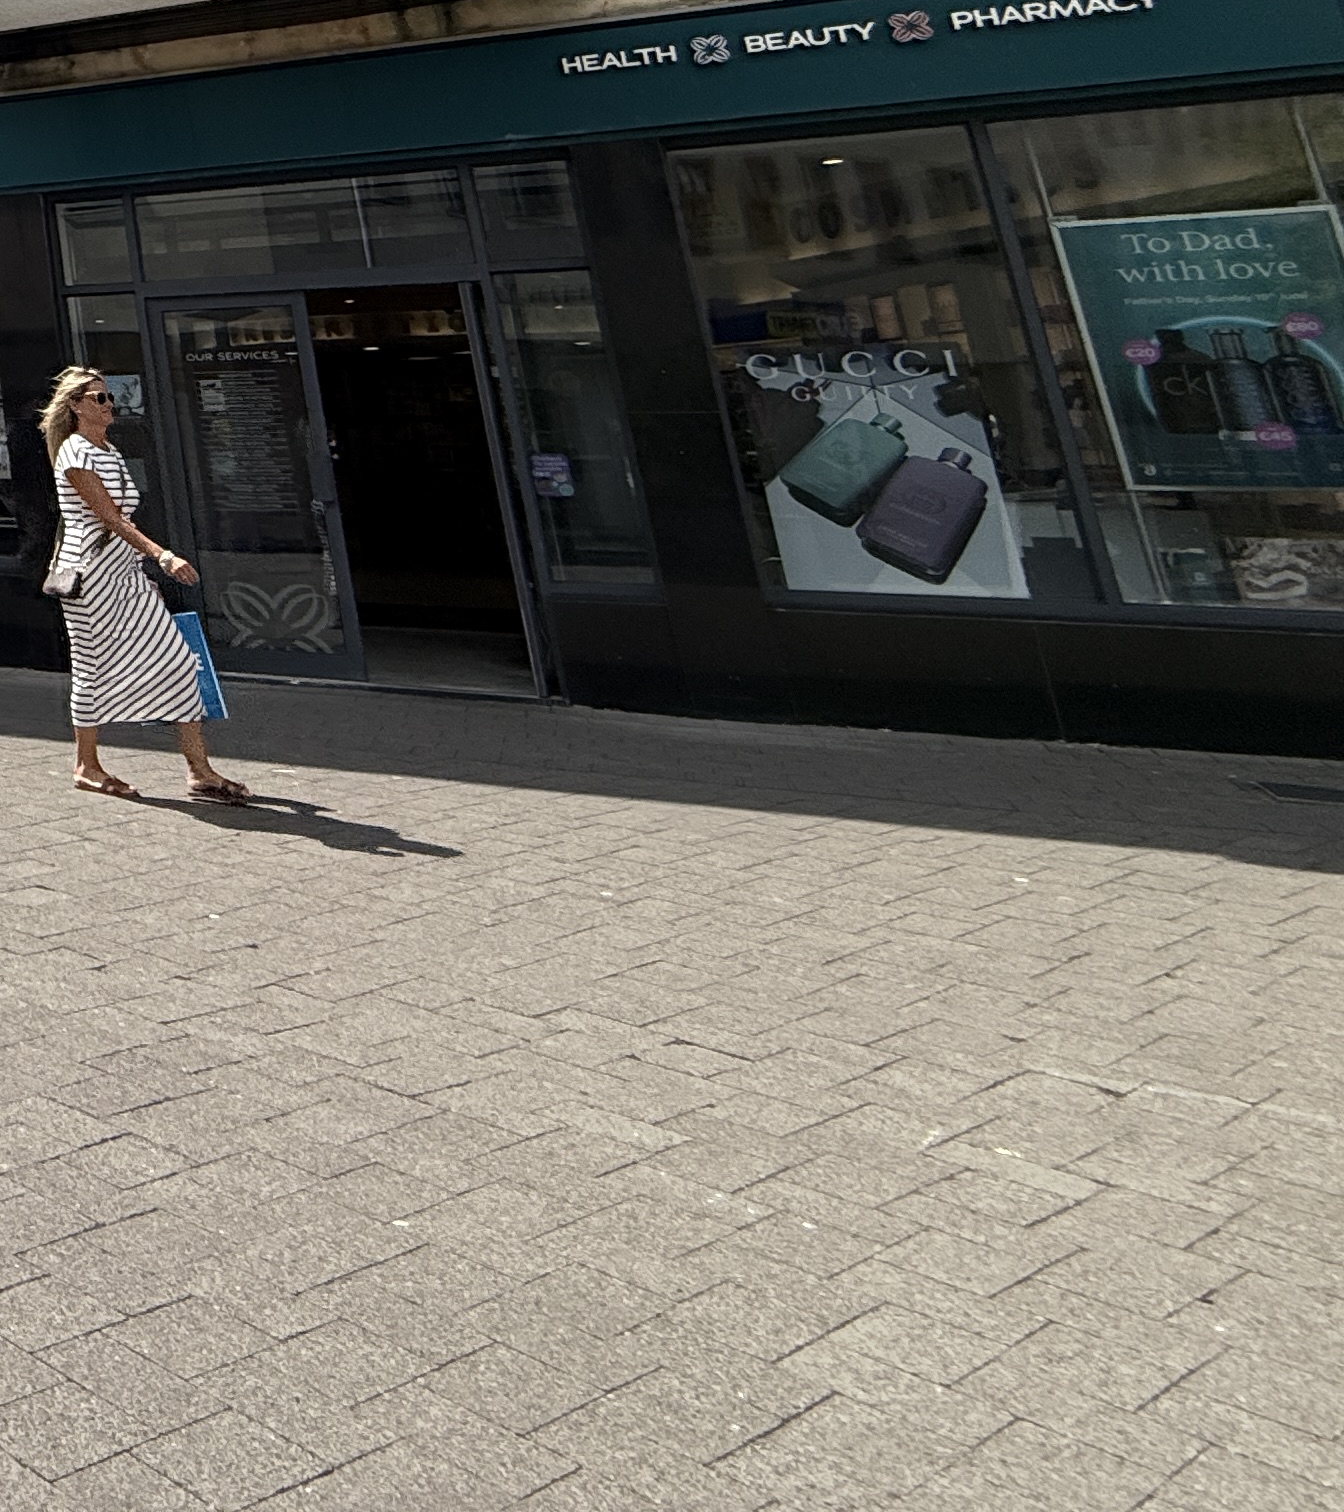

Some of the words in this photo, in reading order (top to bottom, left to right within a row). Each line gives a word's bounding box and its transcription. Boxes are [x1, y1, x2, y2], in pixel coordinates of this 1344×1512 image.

[561, 44, 677, 75] HEALTH
[743, 21, 876, 54] BEAUTY
[1120, 233, 1171, 254] To
[1116, 260, 1205, 284] with
[1212, 259, 1301, 280] love
[185, 352, 213, 362] OUR
[217, 350, 280, 361] SERVICES
[745, 348, 958, 380] GUCCI
